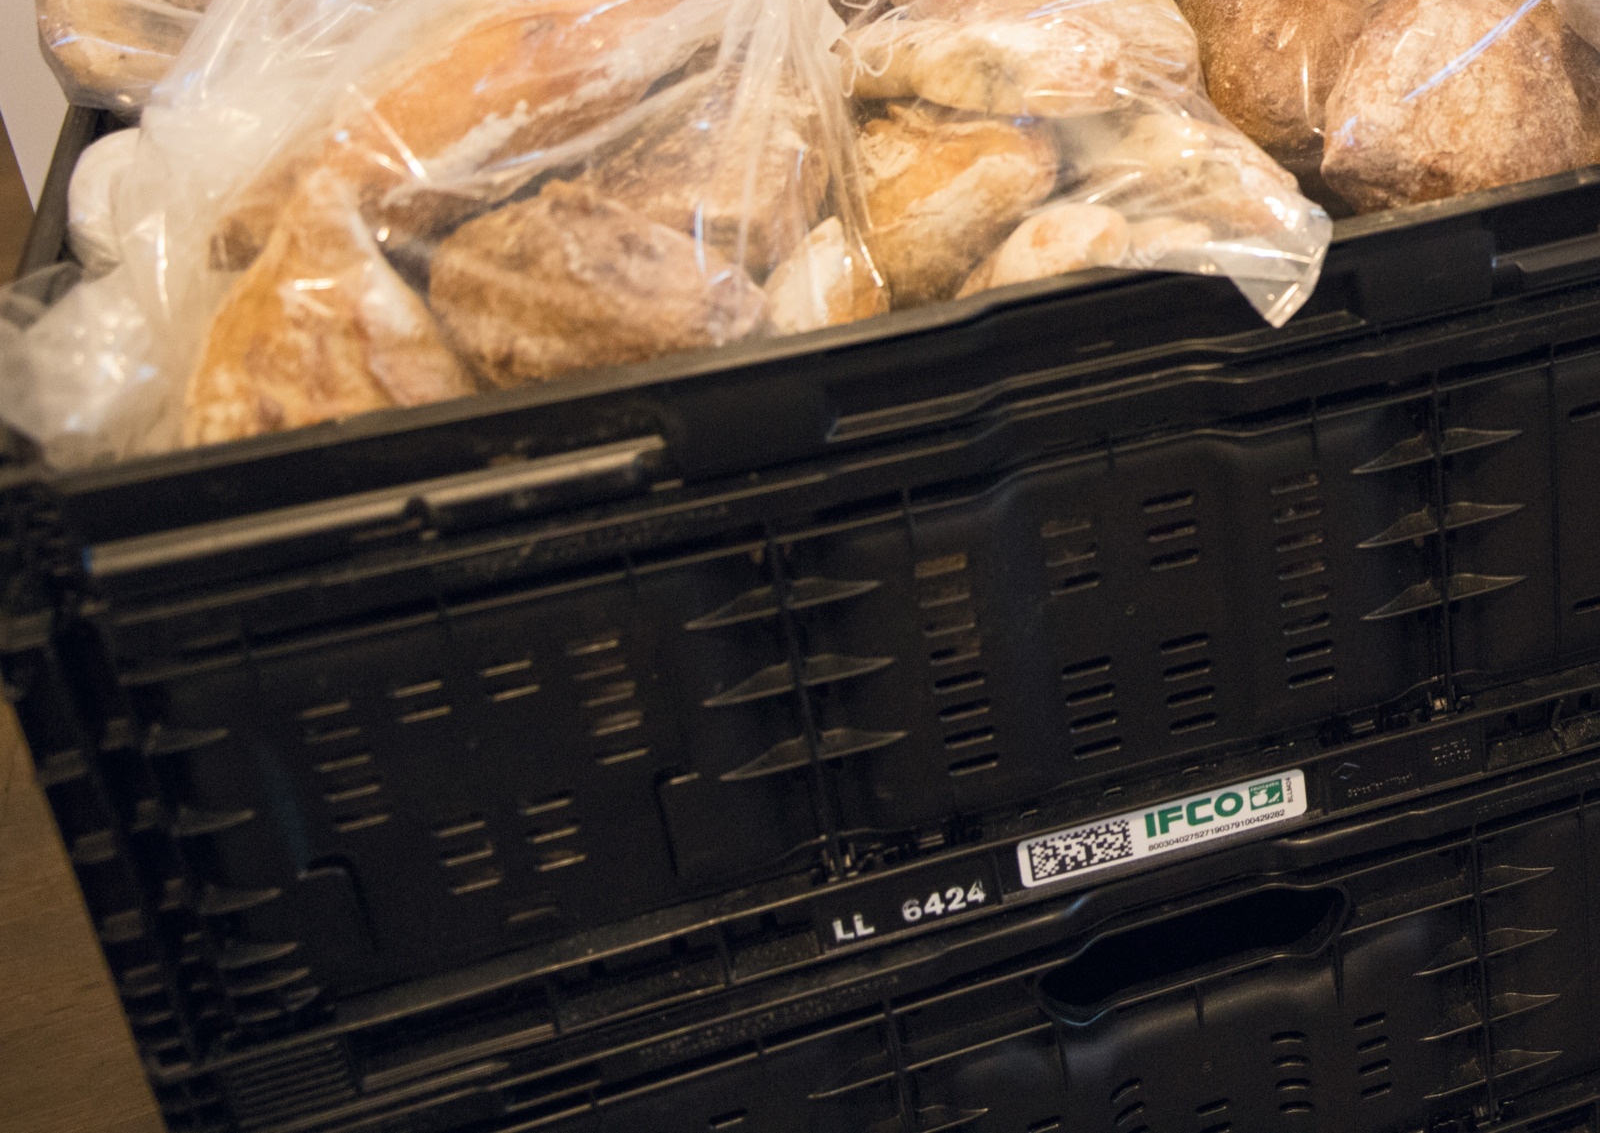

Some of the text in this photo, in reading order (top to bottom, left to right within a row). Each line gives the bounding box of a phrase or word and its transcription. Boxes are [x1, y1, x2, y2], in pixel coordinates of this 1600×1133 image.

[1144, 791, 1244, 839] IFCO
[832, 878, 988, 942] LL 6424
